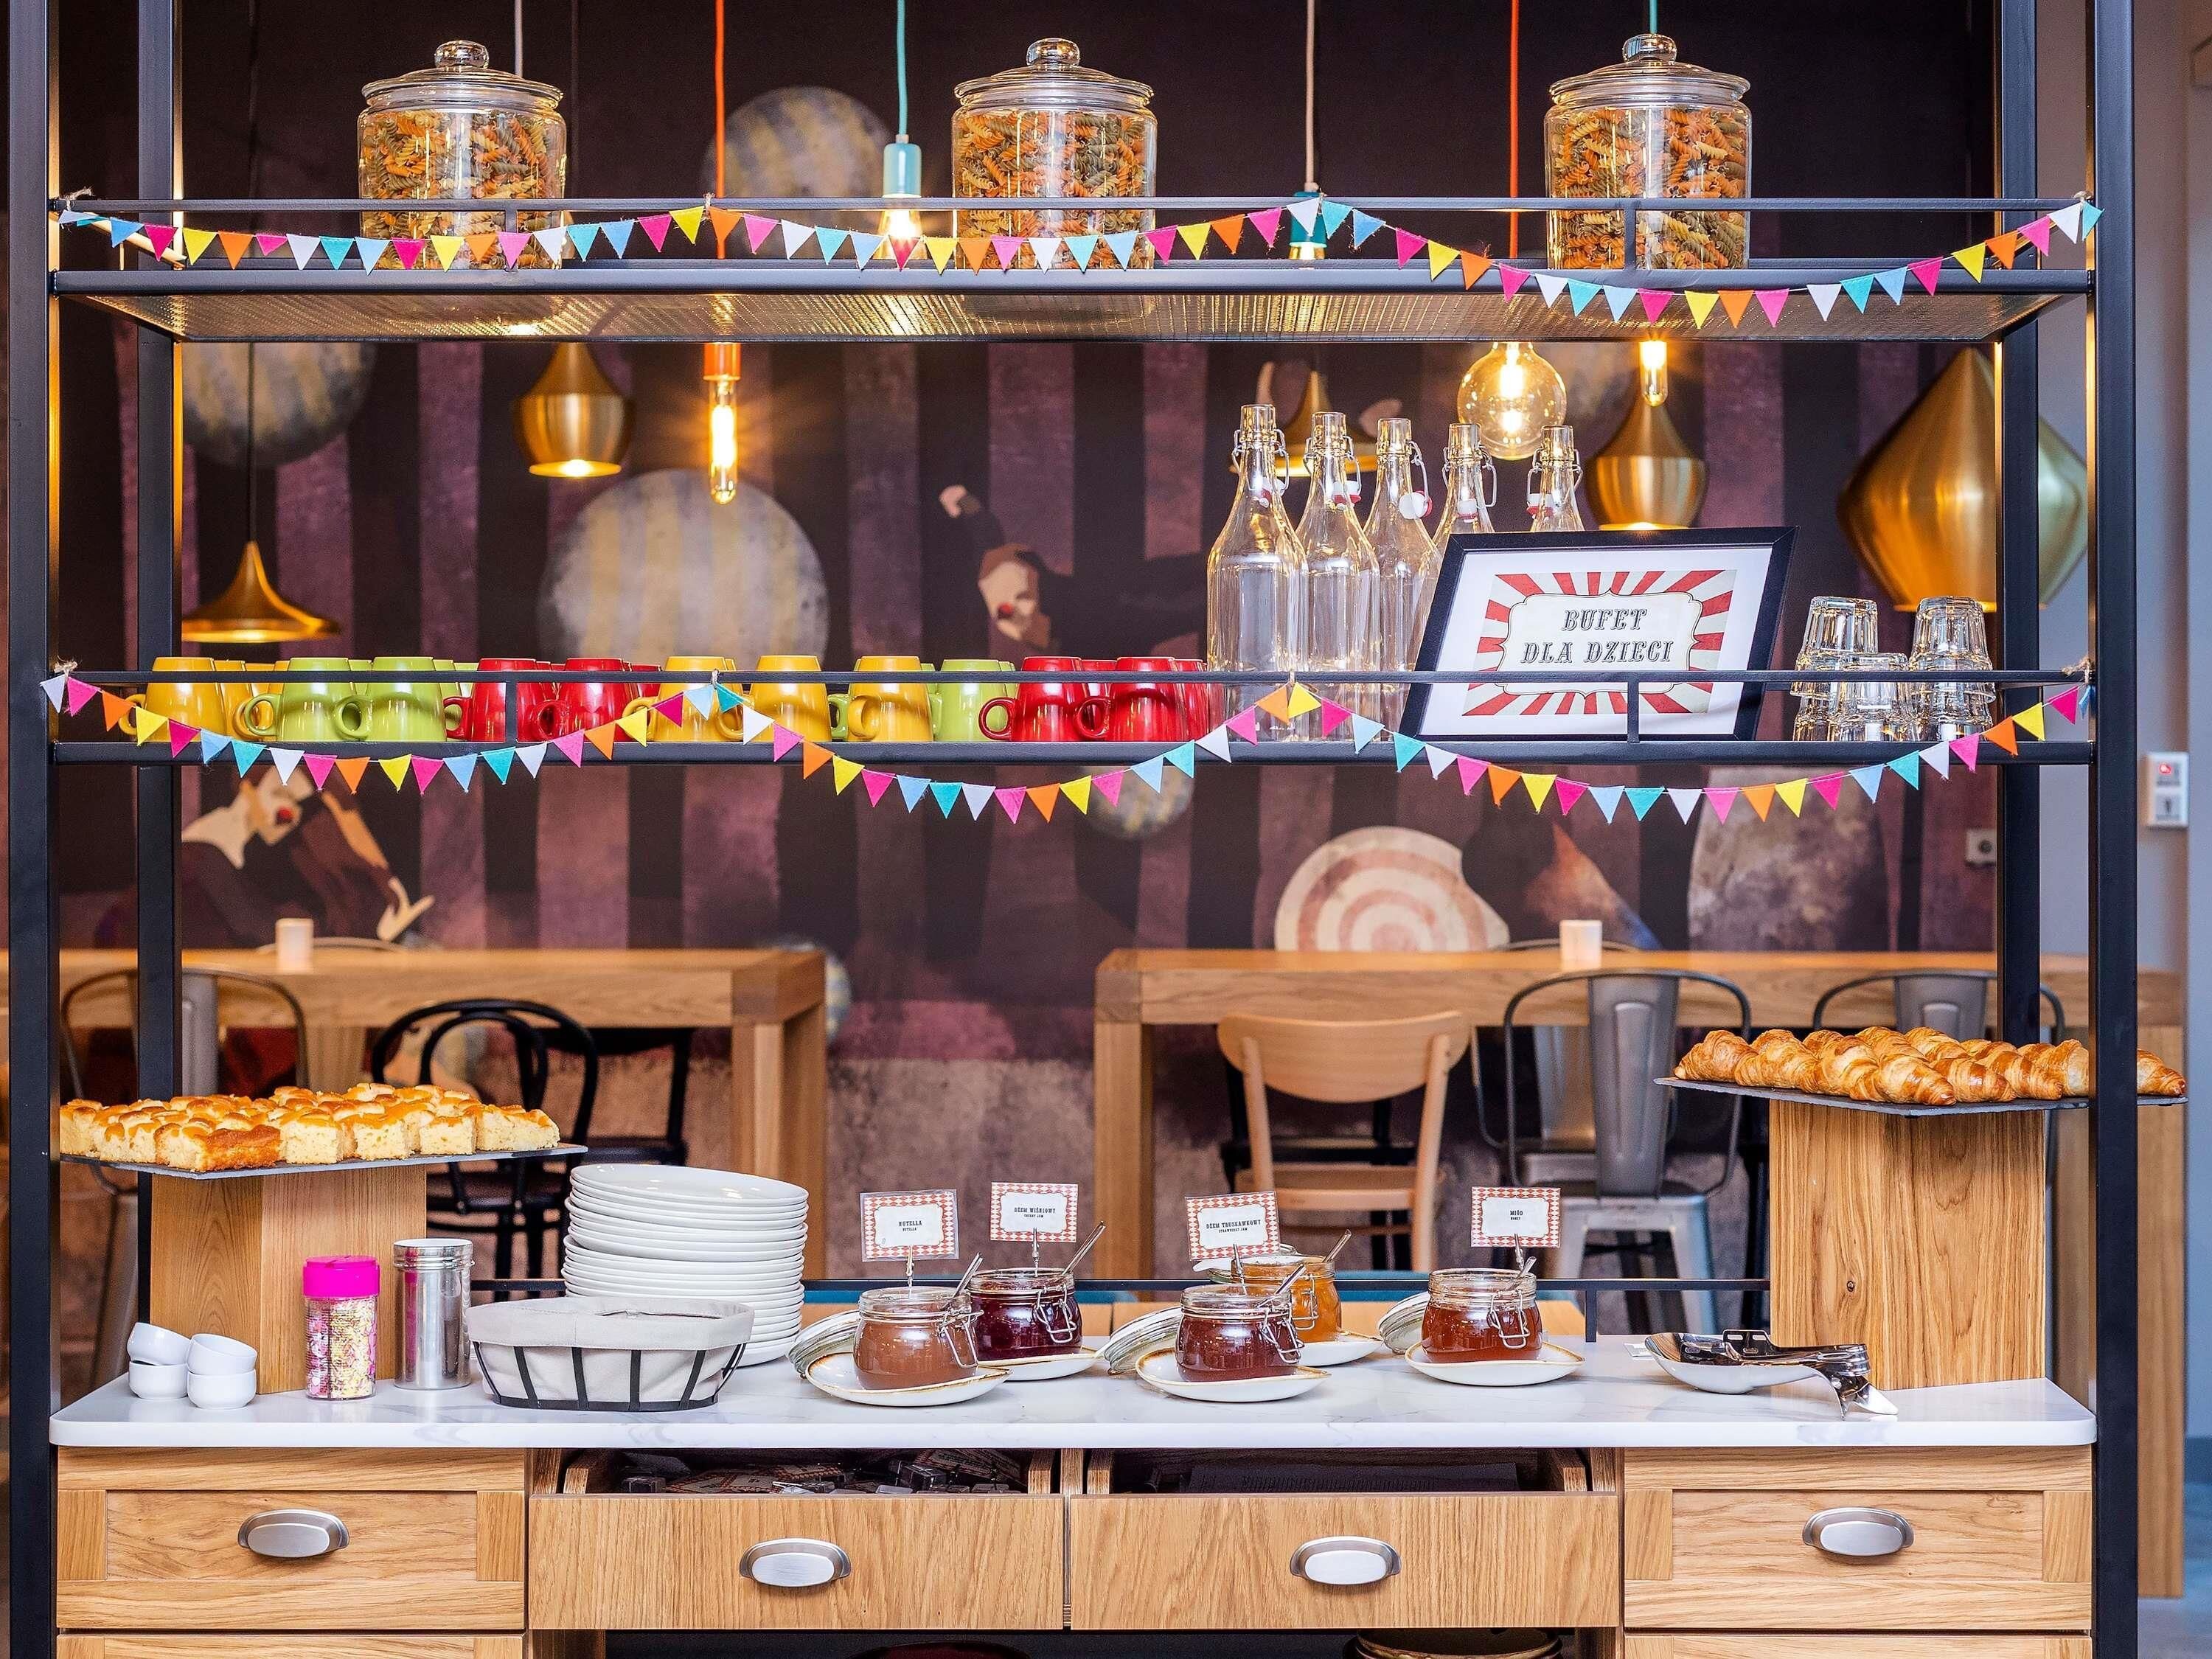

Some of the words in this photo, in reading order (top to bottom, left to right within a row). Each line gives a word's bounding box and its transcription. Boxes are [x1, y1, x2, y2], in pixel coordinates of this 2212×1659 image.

[1562, 608, 1647, 631] BUFET
[1520, 641, 1573, 664] DLA
[1583, 640, 1674, 663] DZIECI
[1221, 1219, 1261, 1228] TRUSKAWKOWY
